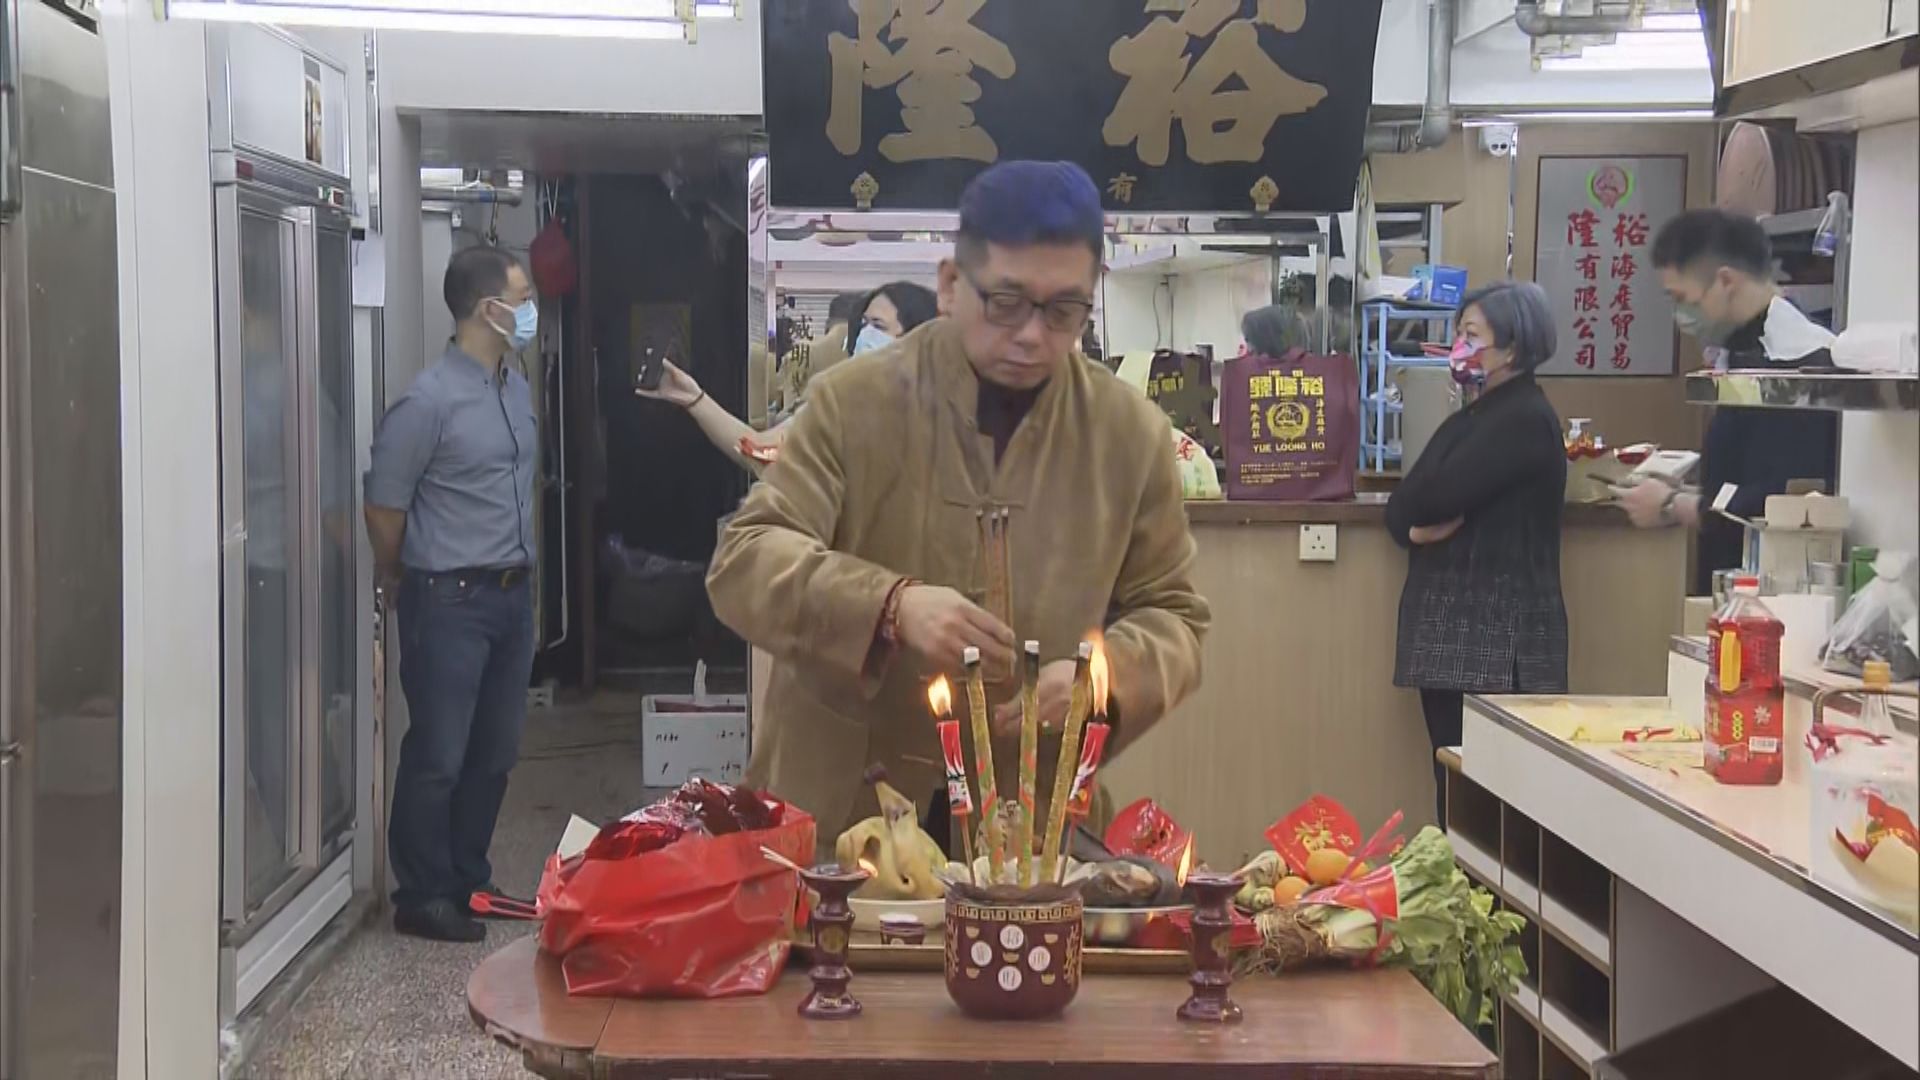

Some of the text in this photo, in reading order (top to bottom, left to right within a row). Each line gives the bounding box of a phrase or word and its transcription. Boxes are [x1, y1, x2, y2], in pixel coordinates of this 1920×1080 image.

[1253, 441, 1326, 453] YUE LOONG HO
